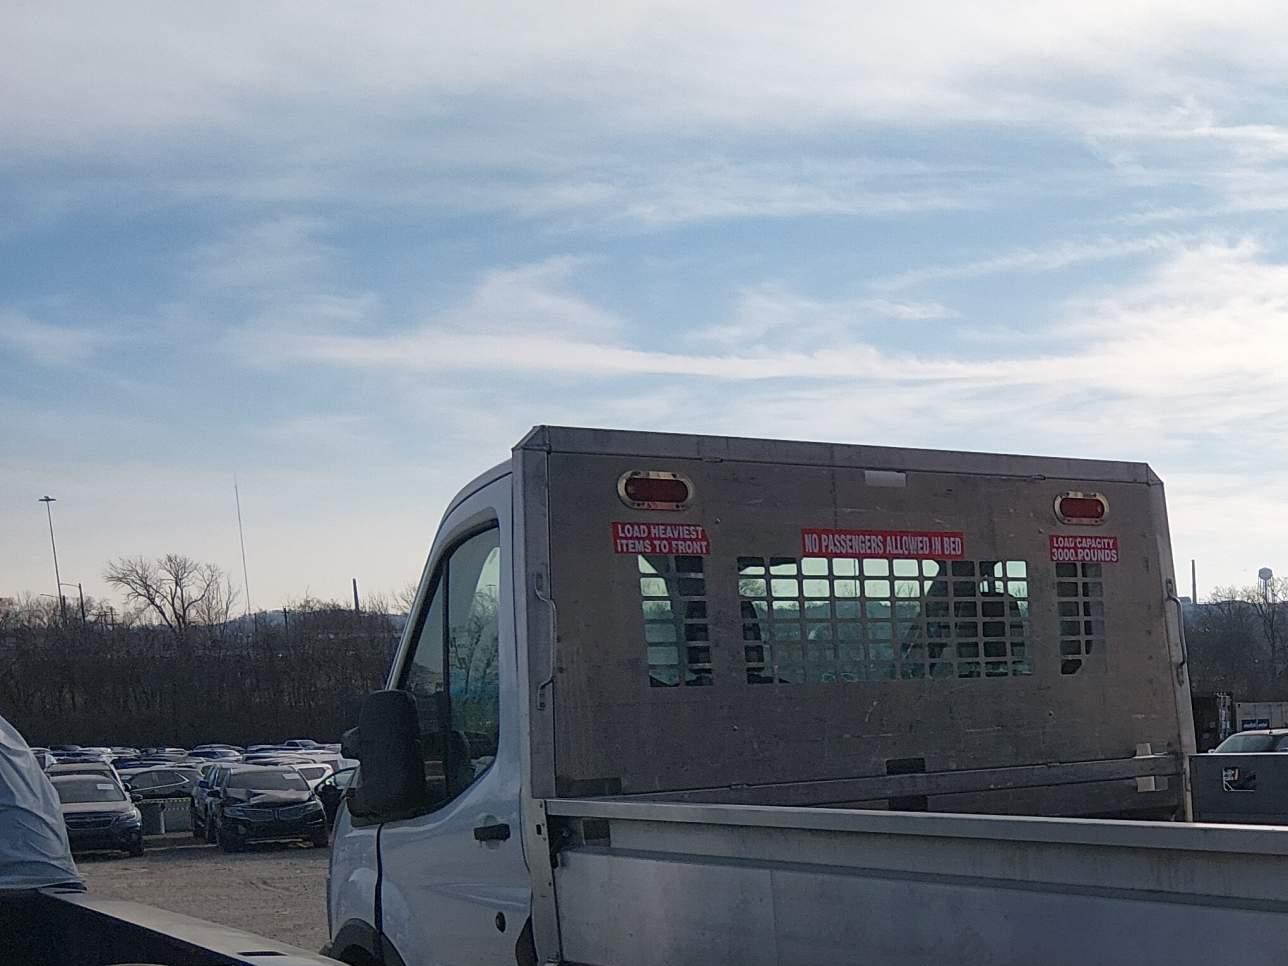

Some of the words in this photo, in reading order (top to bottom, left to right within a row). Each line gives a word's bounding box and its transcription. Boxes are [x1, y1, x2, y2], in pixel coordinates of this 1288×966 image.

[617, 524, 648, 538] LOAD
[650, 525, 703, 540] HEAVIEST
[616, 540, 652, 553] ITEMS
[653, 540, 669, 553] TO
[671, 541, 708, 554] FRONT
[803, 533, 819, 553] NO
[821, 534, 884, 555] PASSENGERS
[886, 535, 930, 555] ALLOWED
[932, 536, 942, 555] IN
[944, 537, 963, 556] BED
[1053, 537, 1075, 548] LOAD
[1076, 538, 1114, 549] CAPACITY
[1051, 548, 1076, 561] 3000
[1077, 549, 1118, 562] POUNDS
